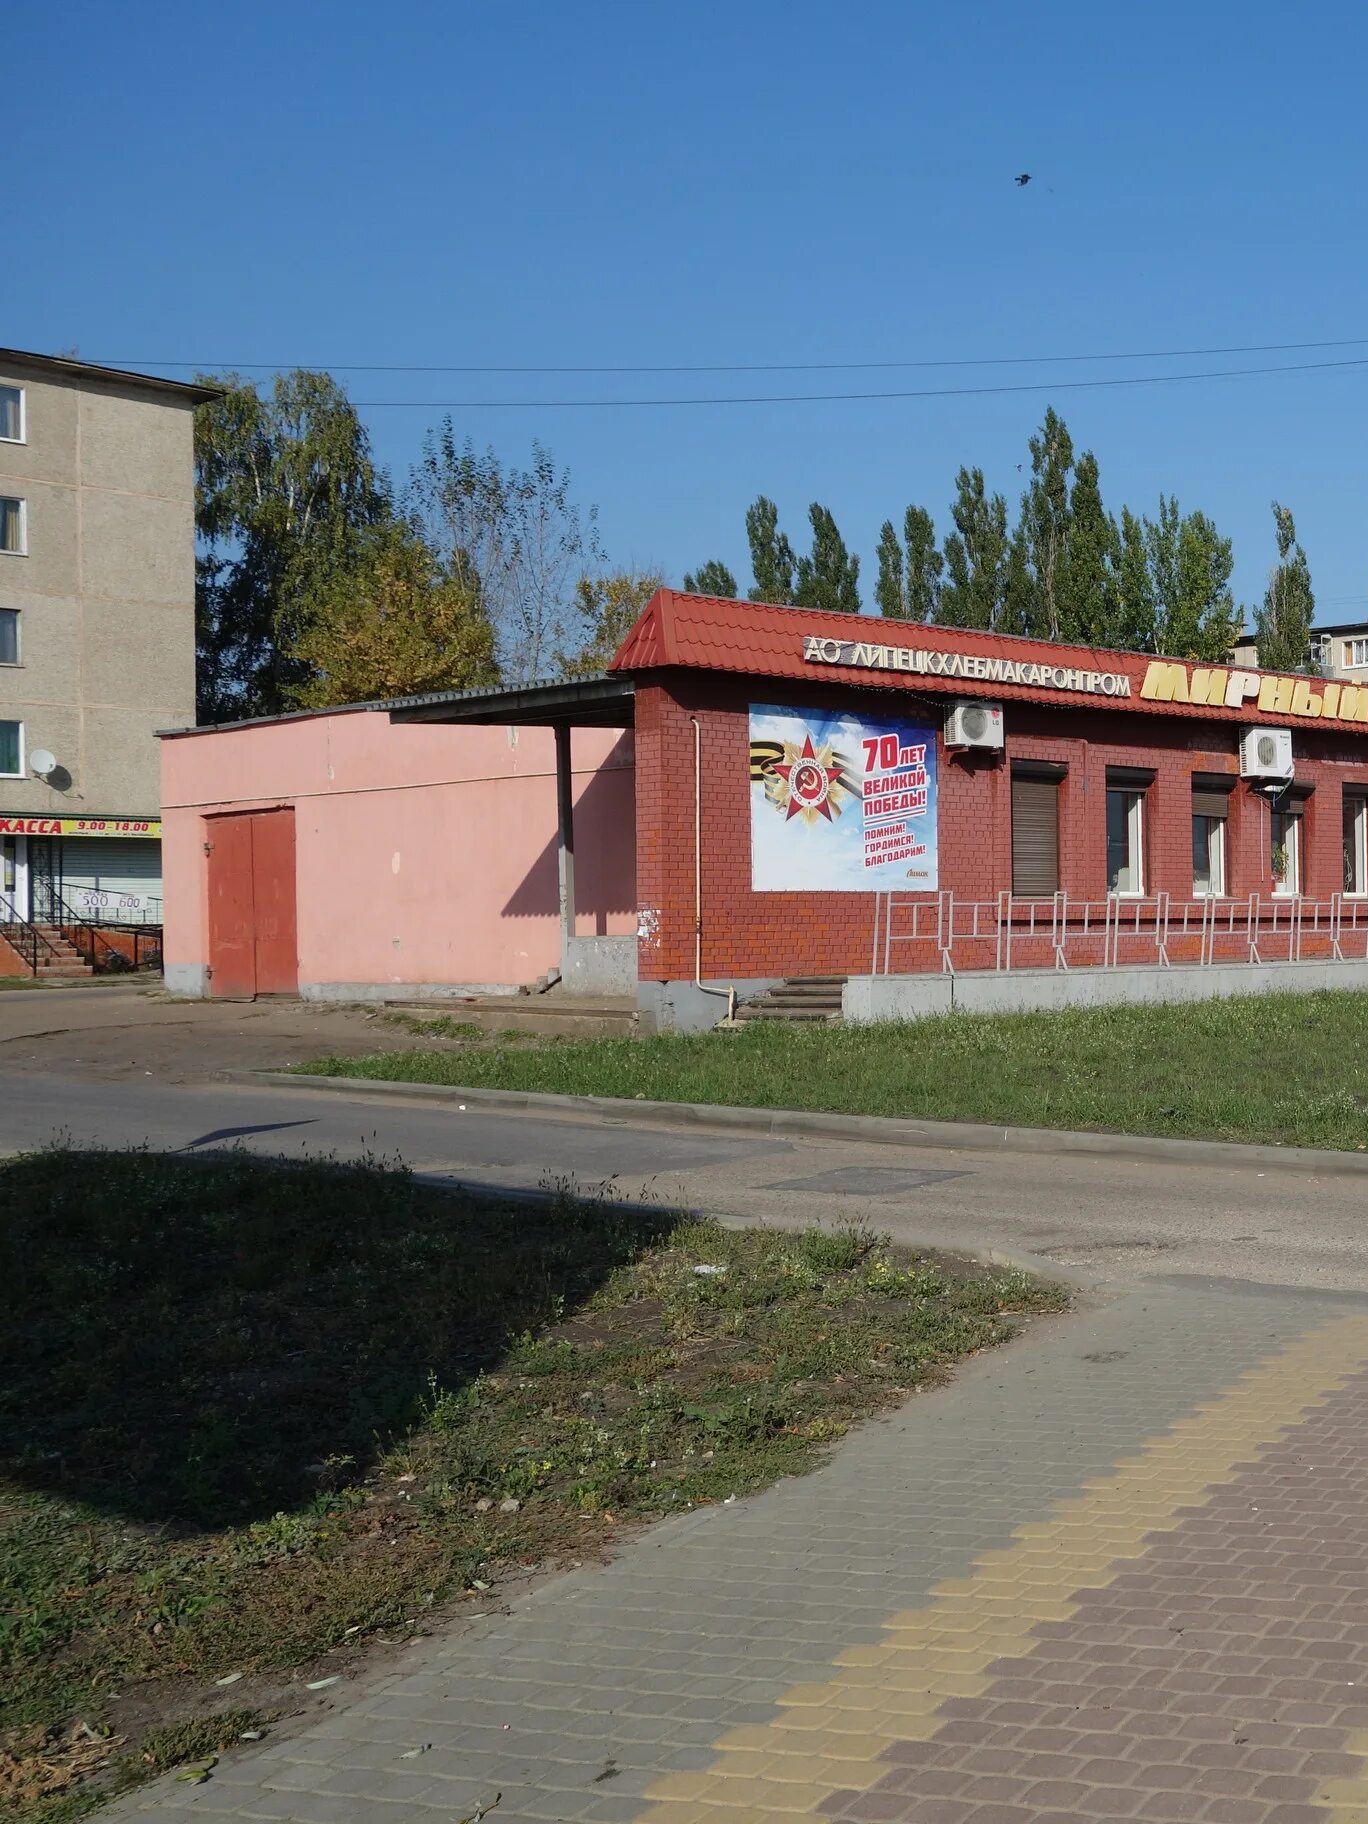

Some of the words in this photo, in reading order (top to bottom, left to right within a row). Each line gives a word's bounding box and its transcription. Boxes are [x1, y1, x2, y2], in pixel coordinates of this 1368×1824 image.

[804, 637, 841, 663] АО
[851, 643, 1131, 697] ЛИПЕЦКХЛЕБМАКАРОНПРОМ
[862, 735, 898, 772] 70
[900, 746, 925, 765] ЛЕТ
[864, 766, 925, 796] ВЕЛИКОЙ
[864, 790, 926, 816] ПОБЕДЫ!
[0, 820, 63, 833] КАССА
[865, 823, 905, 840] ПОМНИМ!
[865, 835, 914, 853] ГОРДИМСЯ!
[865, 845, 925, 867] БЛАГОДАРИМ!
